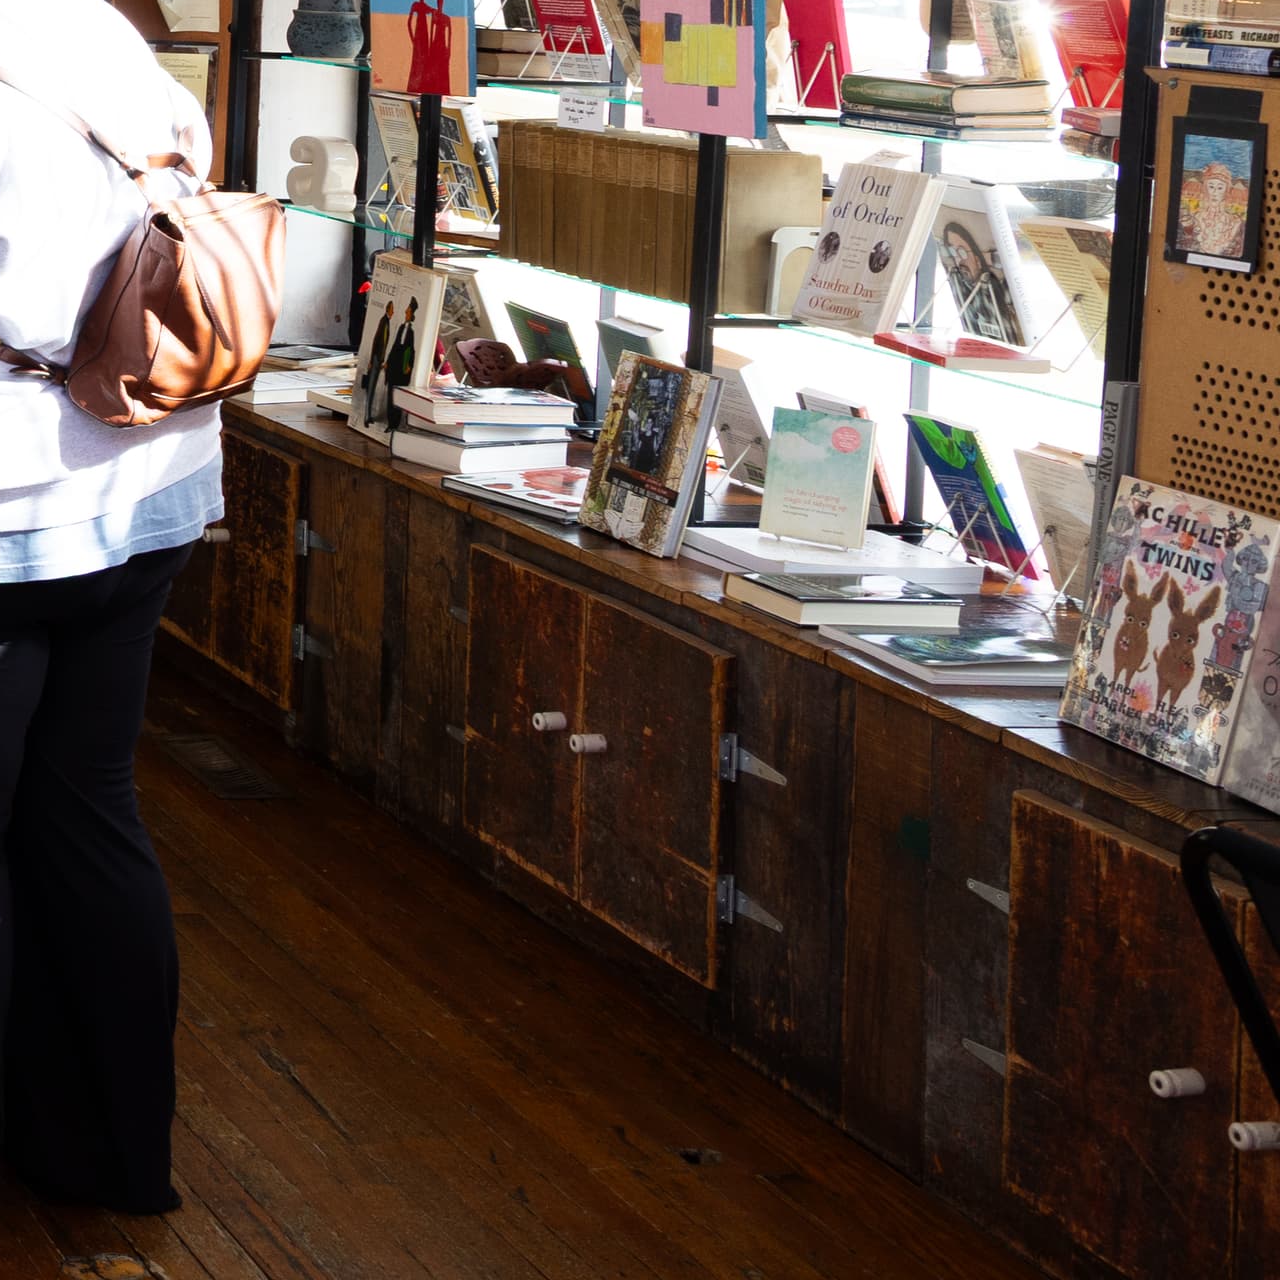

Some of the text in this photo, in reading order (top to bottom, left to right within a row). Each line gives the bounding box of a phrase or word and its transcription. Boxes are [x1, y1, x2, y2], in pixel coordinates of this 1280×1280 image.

[1203, 29, 1280, 43] FEASTS RICHARD
[861, 175, 892, 197] Out
[833, 202, 904, 228] of Order
[808, 275, 875, 300] Sandra Day
[808, 295, 863, 319] O'Connor
[1095, 398, 1122, 483] PAGE ONE
[1136, 502, 1240, 548] ACHILLES
[1140, 541, 1217, 581] TWINS
